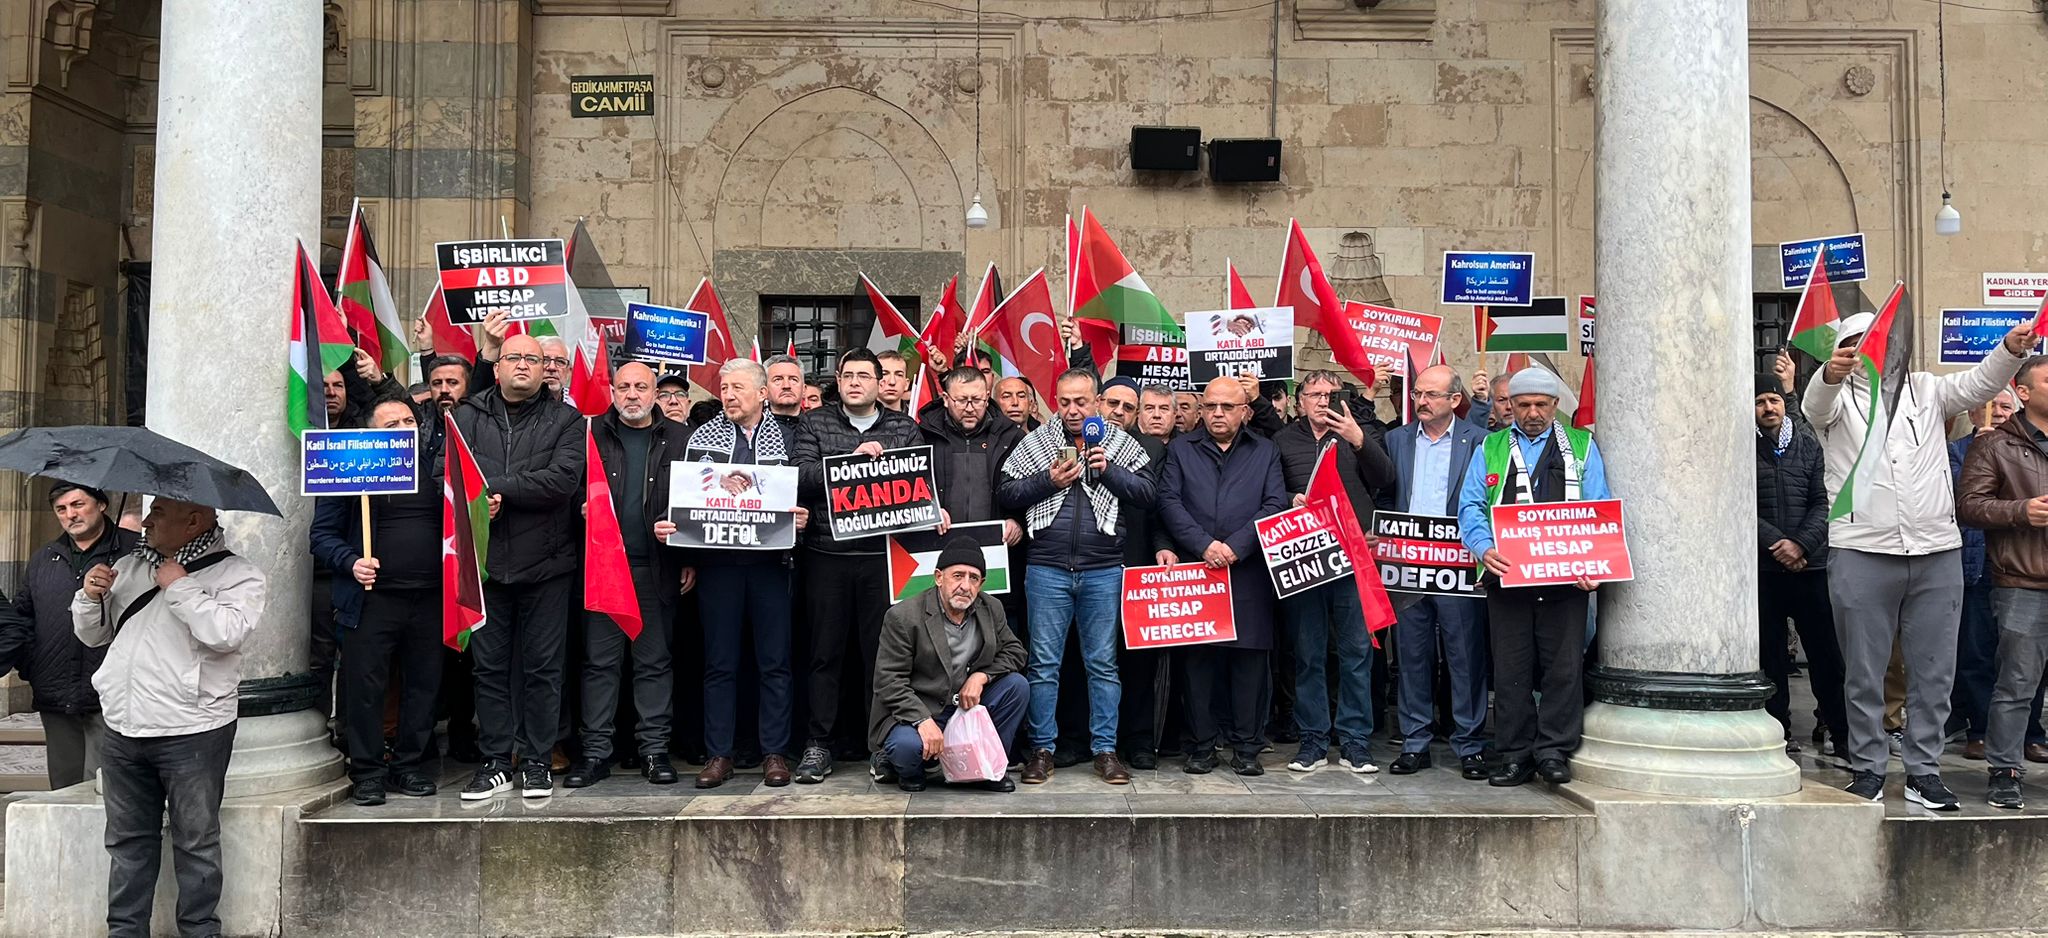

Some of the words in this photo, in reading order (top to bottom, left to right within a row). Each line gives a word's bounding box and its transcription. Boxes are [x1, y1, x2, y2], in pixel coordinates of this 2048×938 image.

[571, 81, 653, 94] GEDİKAHMETPAŞA
[580, 94, 646, 112] CAMİİ
[453, 243, 548, 268] İŞBİRLİKCİ
[1451, 259, 1488, 269] Kahrolsun
[1490, 260, 1521, 270] Amerika
[1986, 278, 2029, 286] KADINLAR
[474, 289, 535, 305] HESAP
[633, 310, 669, 323] Kahrolsun
[670, 316, 698, 328] Amerika
[1363, 309, 1421, 327] SOYKIRIMA
[1944, 317, 1961, 326] Katil
[1962, 315, 1980, 326] İsrail
[1981, 317, 2020, 326] Filistin'den
[1379, 325, 1434, 342] TUTANLAR
[1217, 338, 1243, 349] KATİL
[1142, 365, 1189, 377] HESAP
[306, 440, 325, 451] Katil
[326, 438, 346, 450] İsrail
[347, 439, 388, 450] Filistin'den
[390, 439, 409, 449] Defol
[329, 460, 339, 470] من
[830, 453, 928, 482] DÖKTÜĞÜNÜZ
[366, 475, 378, 483] OUT
[706, 497, 736, 508] KATİL
[831, 477, 932, 513] KANDA
[836, 505, 936, 533] BOĞULACAKSINIZ
[1518, 507, 1597, 522] SOYKIRIMA
[702, 523, 761, 545] DEFOL
[1261, 516, 1297, 546] KATİL
[1379, 518, 1424, 537] KATİL
[1501, 527, 1541, 540] ALKIŞ
[1544, 522, 1618, 537] TUTANLAR
[1281, 531, 1337, 559] GAZZE'D
[1529, 540, 1593, 557] HESAP
[1141, 569, 1206, 584] SOYKIRIMA
[1279, 553, 1325, 589] ELİNİ
[1328, 549, 1352, 575] ÇE
[1381, 565, 1474, 591] DEFOL
[1519, 559, 1612, 579] VERECEK
[1126, 588, 1158, 601] ALKIŞ
[1160, 583, 1226, 598] TUTANLAR
[1148, 600, 1203, 619] HESAP
[1140, 621, 1217, 641] VERECEK
